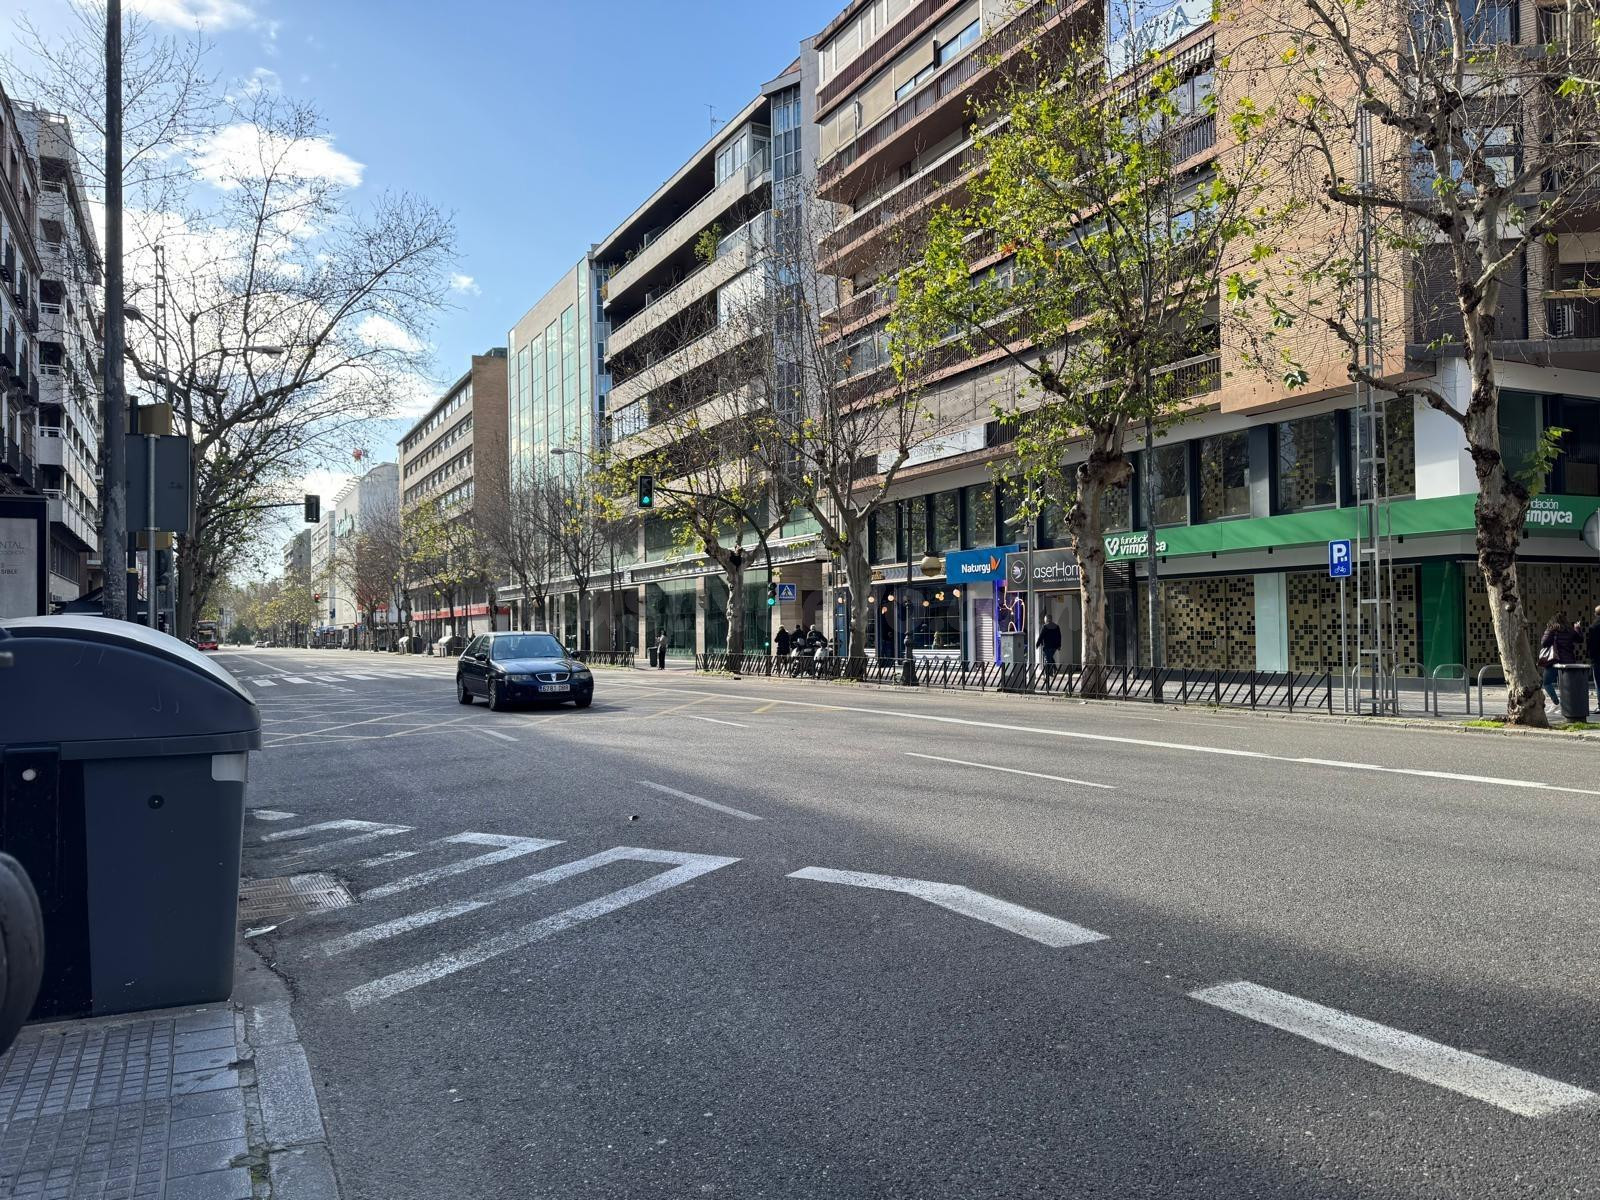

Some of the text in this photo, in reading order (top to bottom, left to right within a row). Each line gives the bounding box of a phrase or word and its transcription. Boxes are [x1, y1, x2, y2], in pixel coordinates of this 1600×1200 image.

[1526, 509, 1573, 526] impyca
[1120, 533, 1149, 545] fundaci
[1120, 541, 1167, 556] vimpca
[1332, 543, 1347, 564] P
[961, 563, 991, 574] Naturgy
[1033, 561, 1081, 579] aserHom
